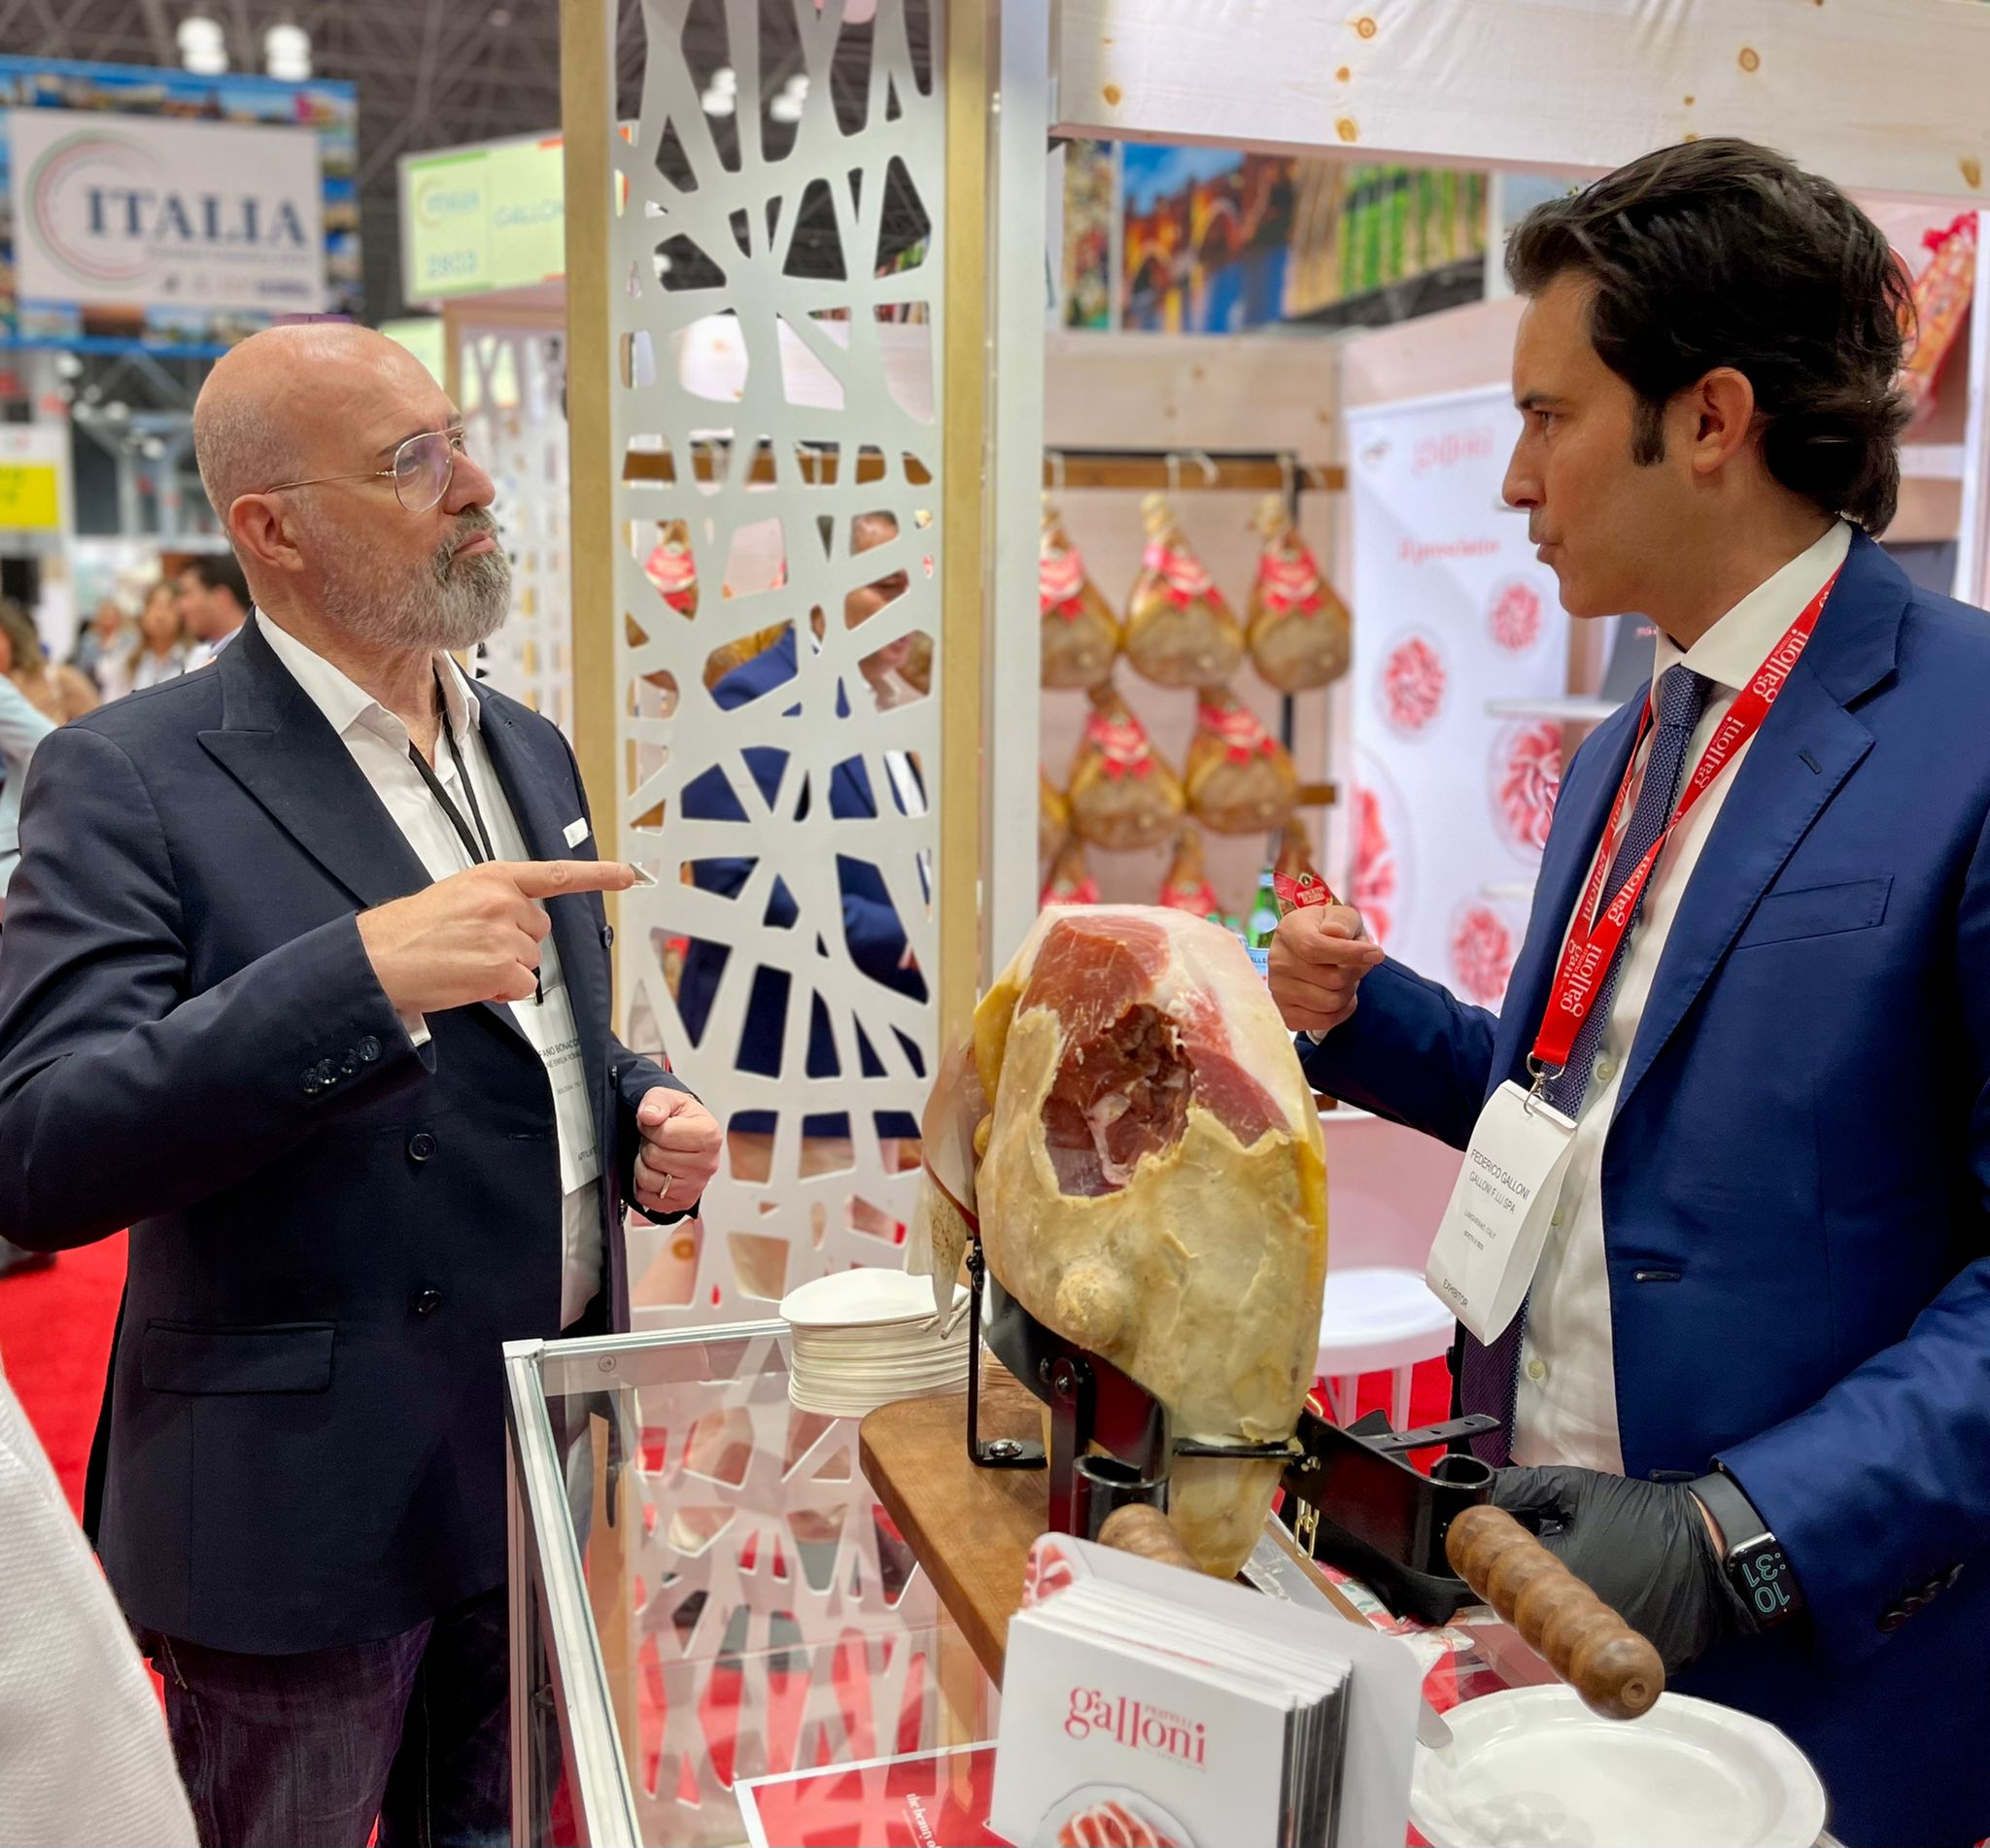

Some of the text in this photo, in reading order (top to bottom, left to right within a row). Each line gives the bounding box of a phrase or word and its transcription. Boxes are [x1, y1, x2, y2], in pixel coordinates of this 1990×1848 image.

[86, 188, 308, 244] ITALIA
[1752, 628, 1809, 703] galloni
[1694, 715, 1747, 789] galloni
[1560, 941, 1603, 1018] galloni
[1468, 1170, 1492, 1195] GALLONI
[1470, 1147, 1530, 1200] FEDERICO GALLONI
[1443, 1278, 1468, 1310] EXHIBITOR
[1064, 1686, 1206, 1766] galloni
